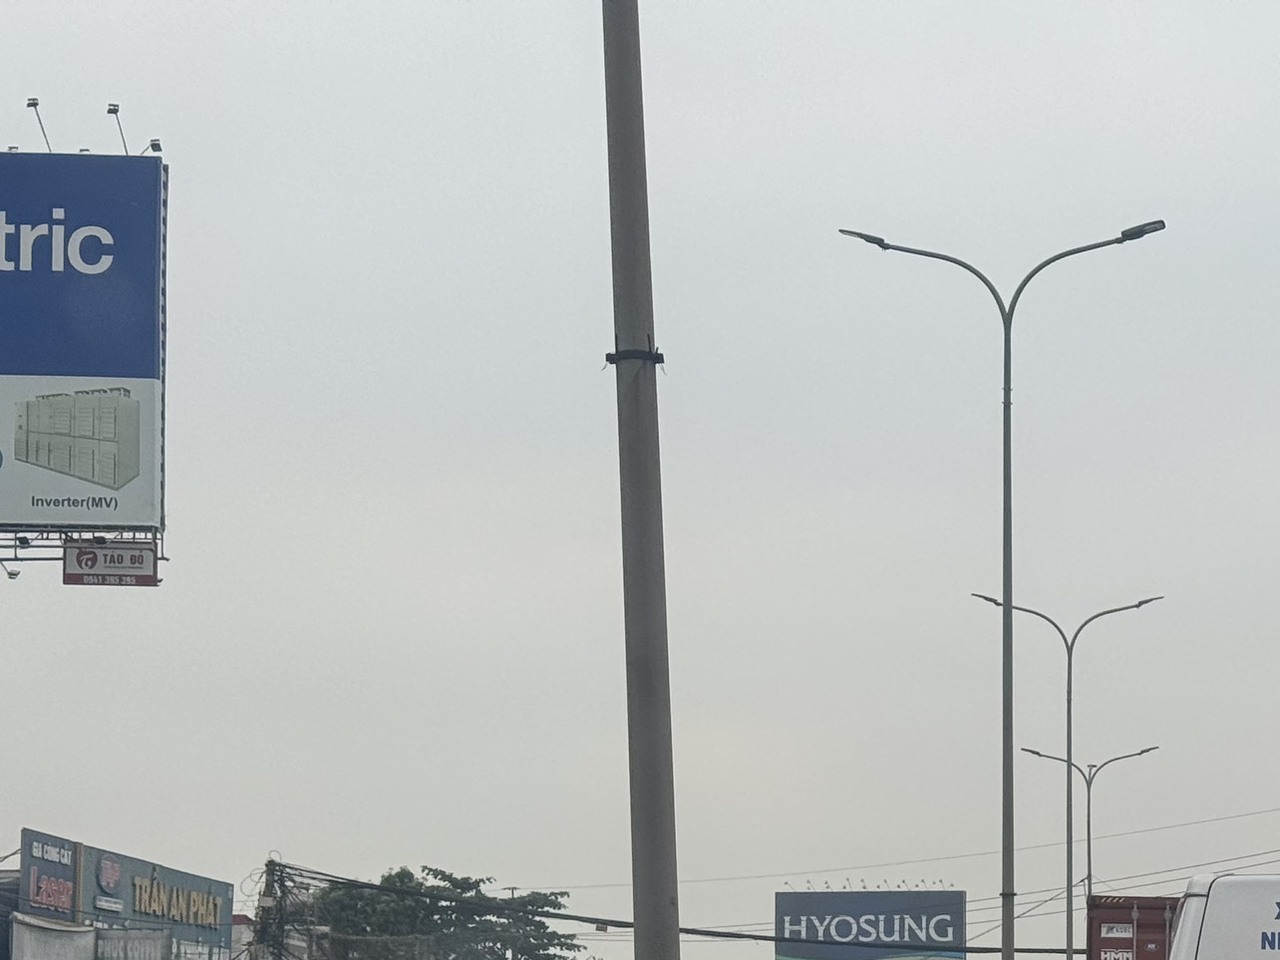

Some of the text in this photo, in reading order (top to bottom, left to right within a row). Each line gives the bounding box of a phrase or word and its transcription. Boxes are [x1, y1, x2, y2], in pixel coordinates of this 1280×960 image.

[31, 495, 118, 511] Inverter(MV)
[29, 866, 74, 912] Laser
[169, 885, 188, 923] AN
[783, 914, 954, 943] HYOSUNG
